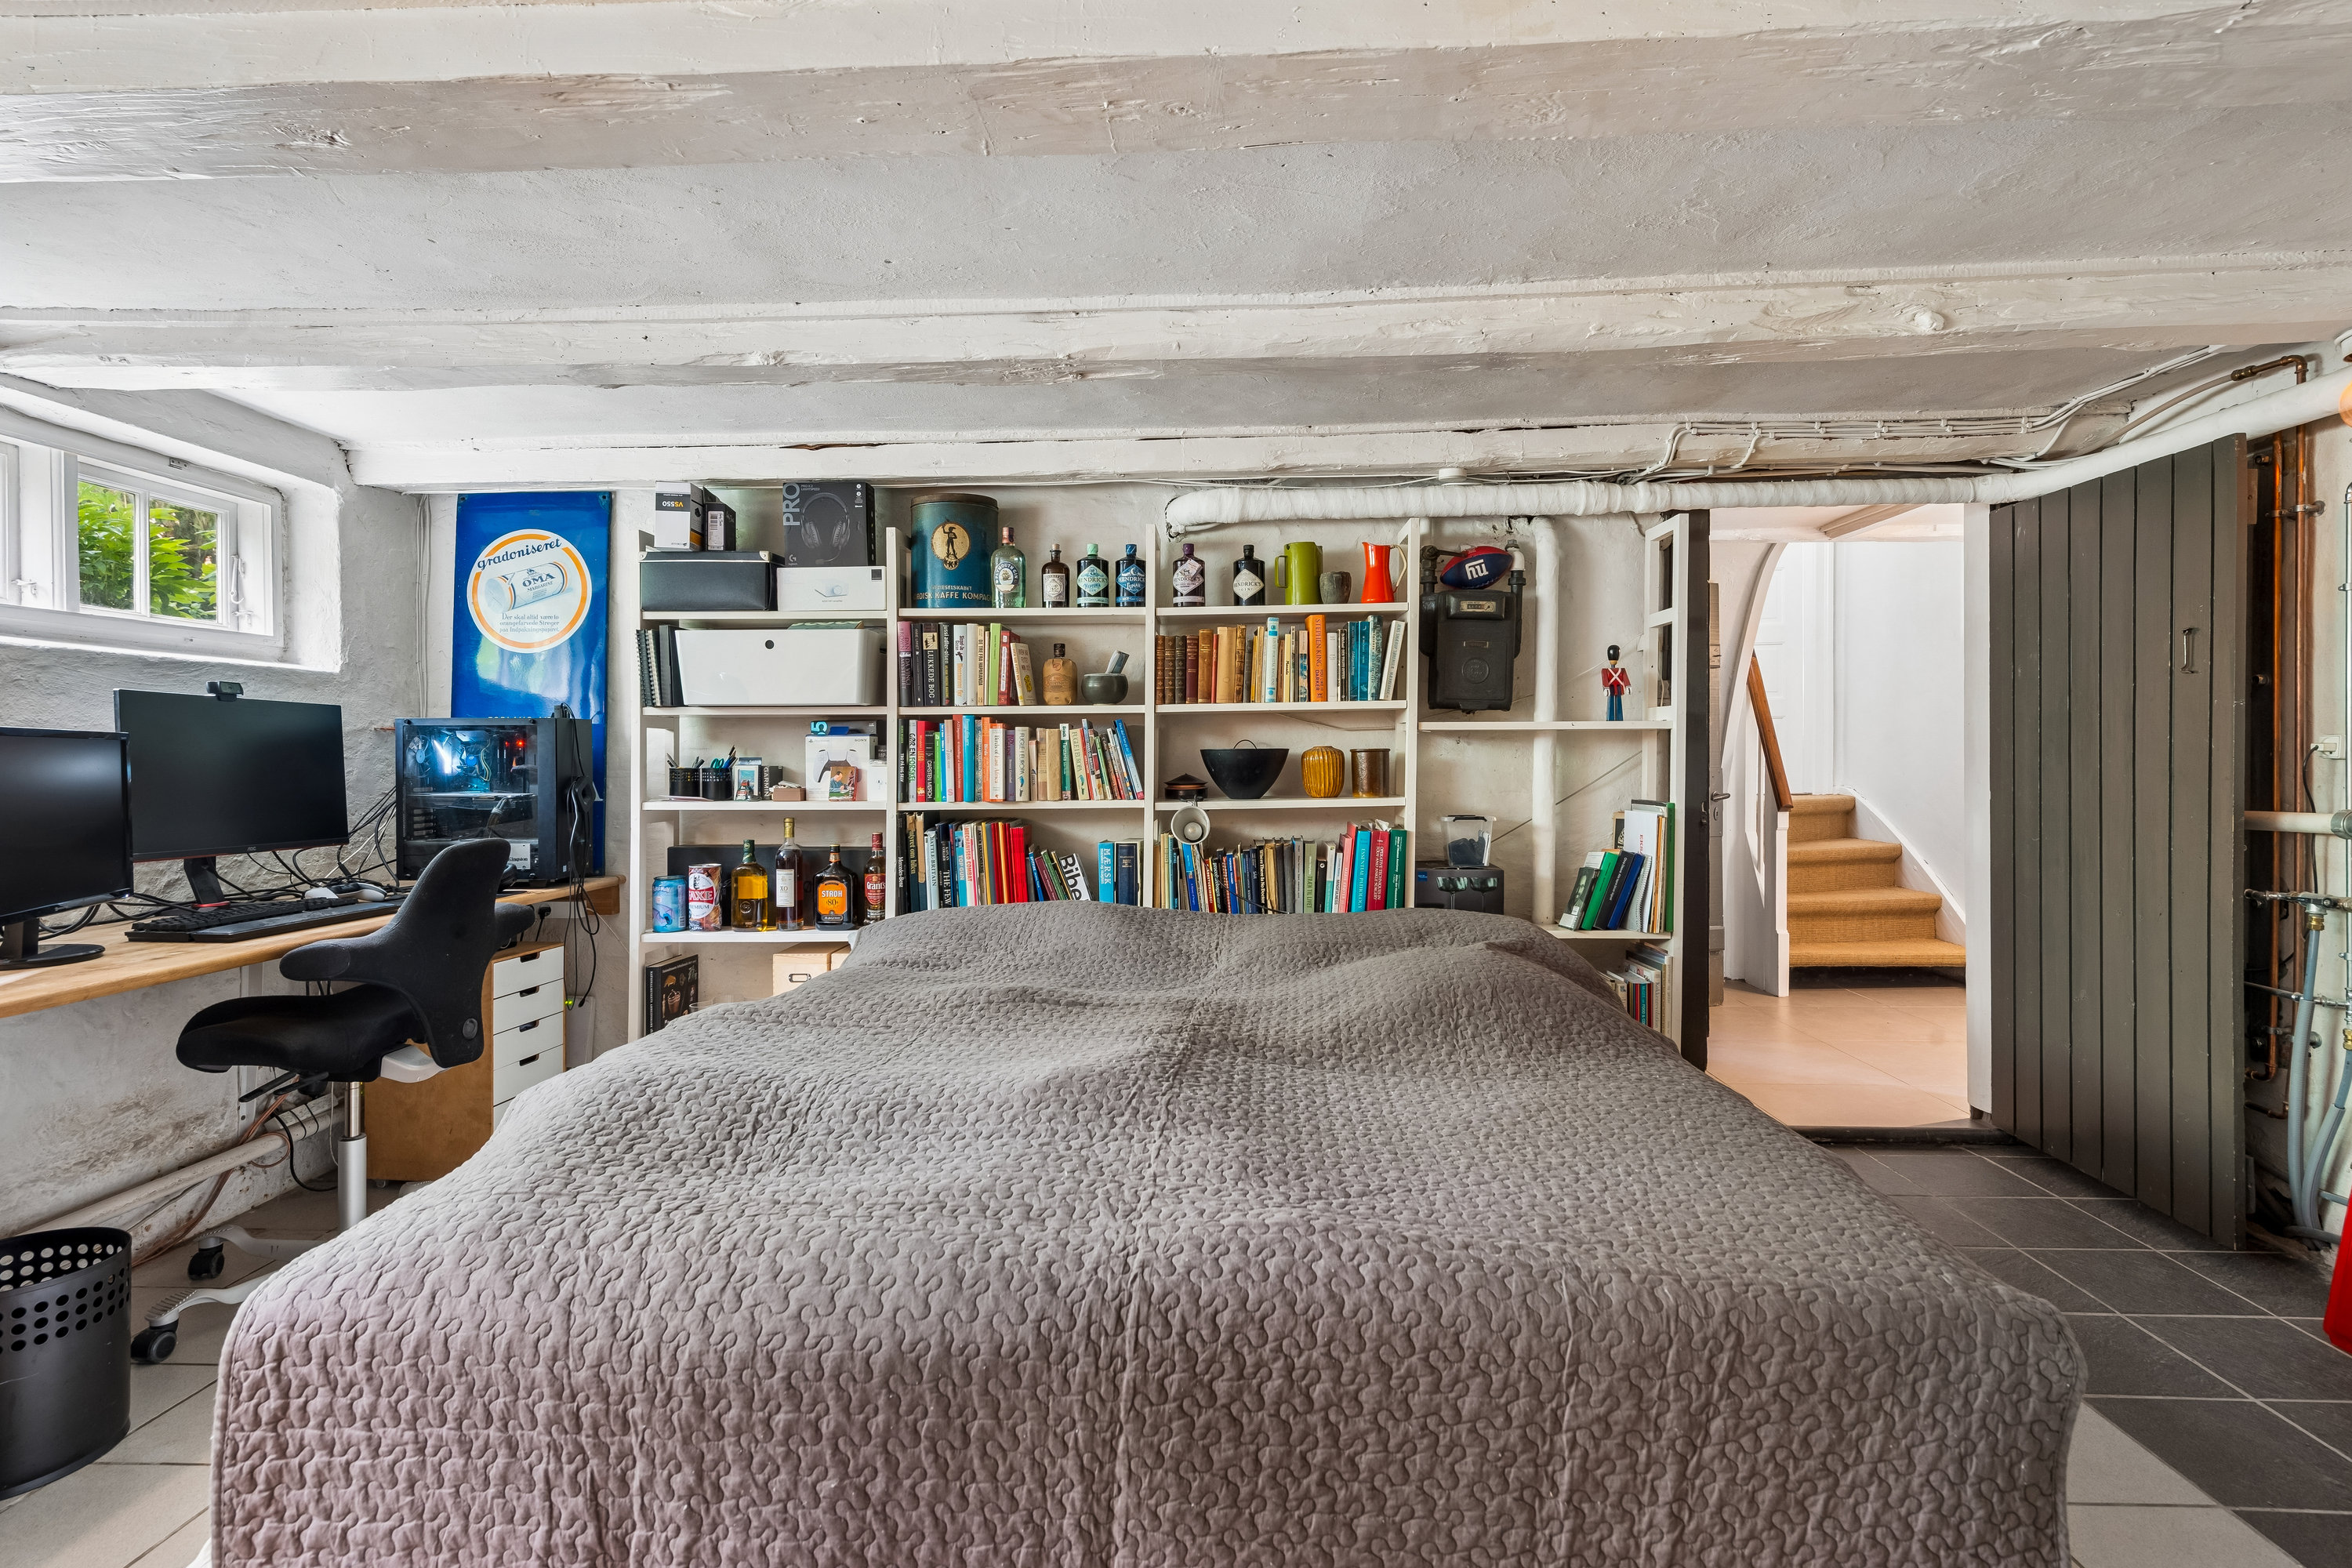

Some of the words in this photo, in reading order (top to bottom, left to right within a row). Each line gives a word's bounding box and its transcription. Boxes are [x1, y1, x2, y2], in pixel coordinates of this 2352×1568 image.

[783, 483, 800, 526] PRO
[477, 539, 562, 571] gradoniseret
[522, 573, 556, 587] OMA
[909, 747, 916, 756] EN
[1074, 752, 1083, 772] EUROPA
[909, 848, 916, 858] om
[1103, 848, 1112, 884] MÆRSK
[866, 881, 887, 890] Grant's
[1059, 854, 1089, 902] Bibe
[688, 891, 713, 901] AXE
[943, 889, 952, 905] FEW
